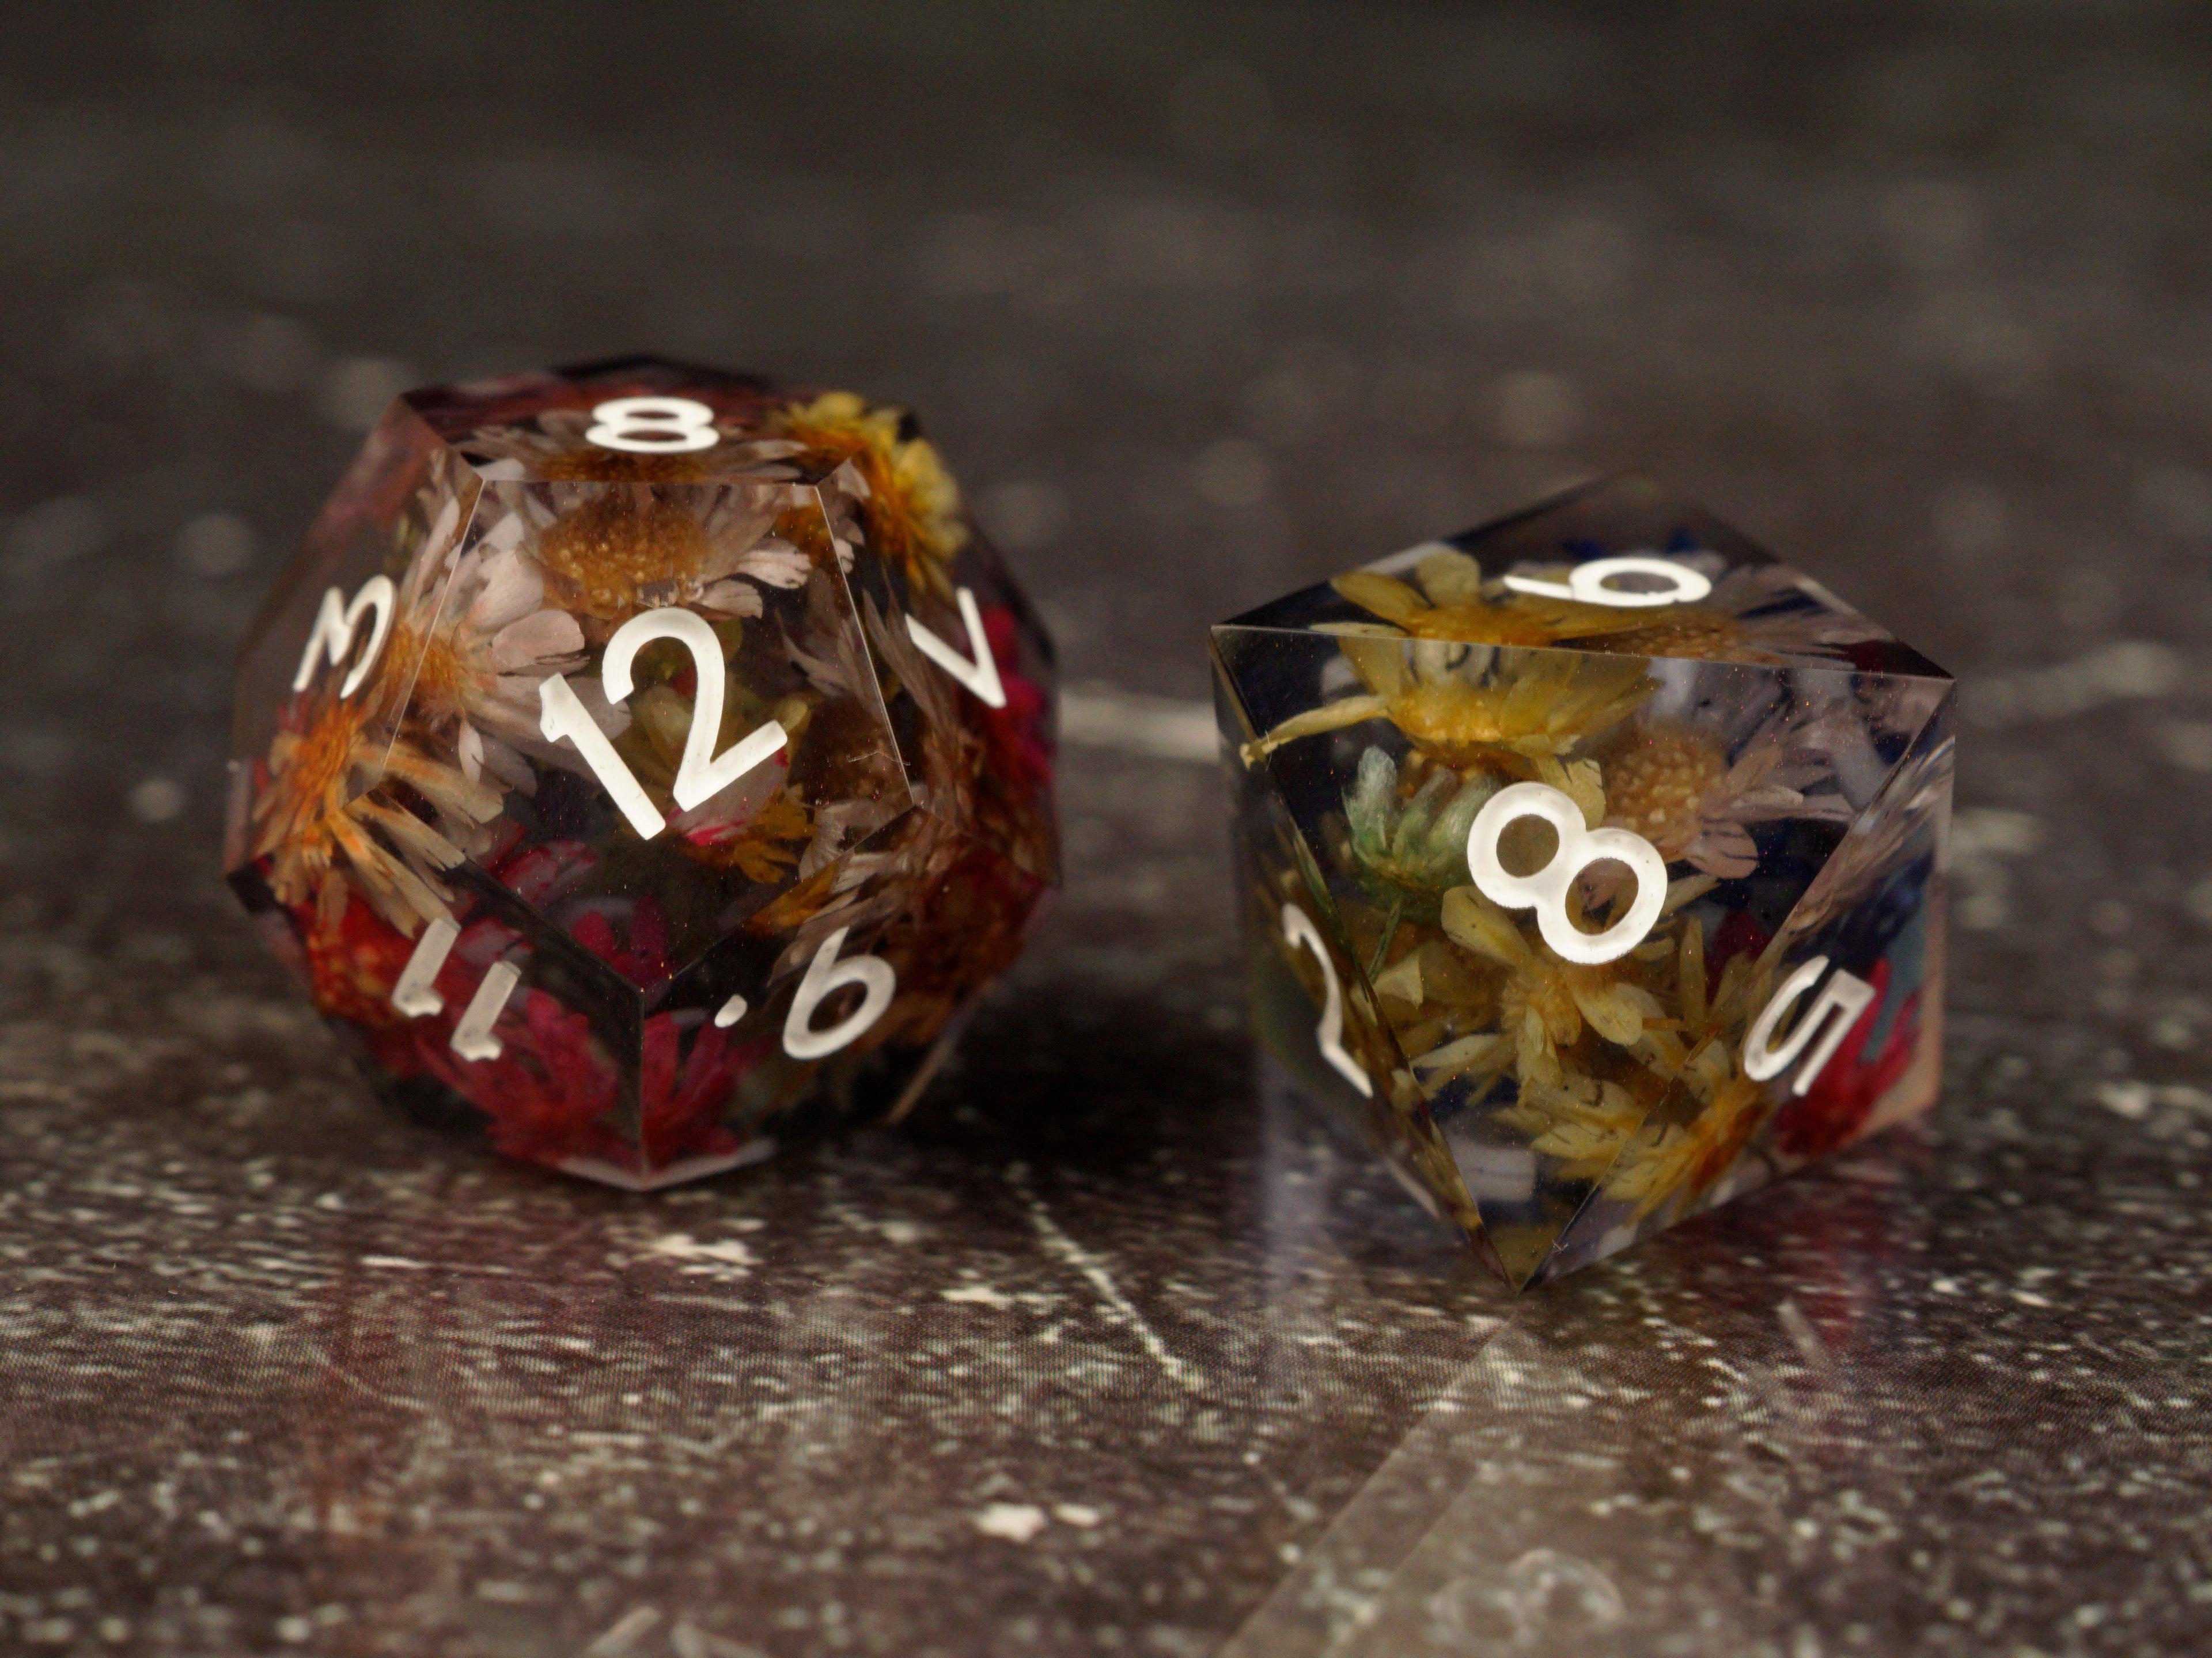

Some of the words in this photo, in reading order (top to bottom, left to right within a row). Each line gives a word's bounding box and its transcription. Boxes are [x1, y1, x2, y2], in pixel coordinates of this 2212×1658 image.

[586, 397, 719, 453] 8
[292, 575, 395, 699] 3
[539, 607, 788, 840] 12
[1467, 782, 1668, 965] 8
[392, 918, 522, 1062] 11
[1282, 903, 1374, 1098] 2
[1743, 955, 1875, 1097] 5
